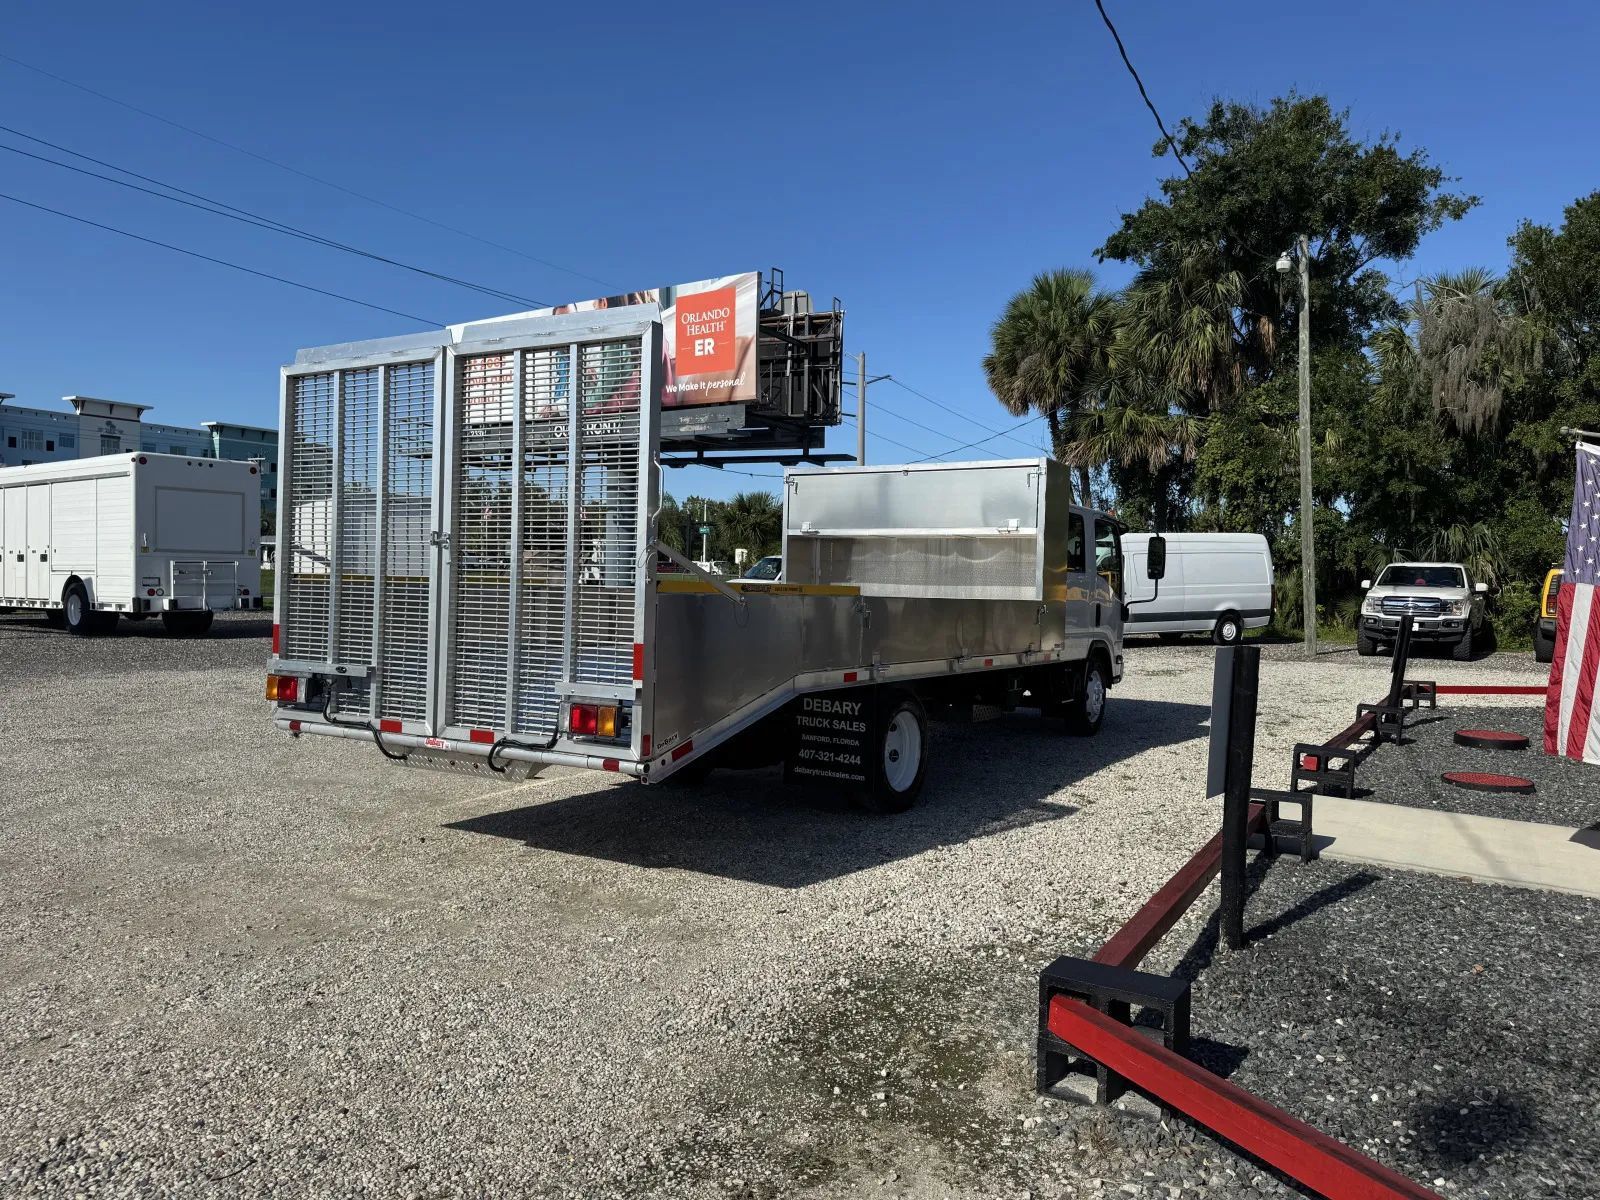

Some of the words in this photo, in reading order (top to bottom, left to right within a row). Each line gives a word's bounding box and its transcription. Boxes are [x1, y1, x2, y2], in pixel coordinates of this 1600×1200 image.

[681, 307, 730, 325] ORLANDO
[687, 321, 724, 336] HEALTH
[694, 337, 715, 357] ER
[665, 384, 677, 393] We
[678, 381, 699, 393] Make
[705, 371, 746, 397] personal
[803, 697, 862, 715] DEBARY
[796, 716, 830, 728] TRUCK
[832, 719, 866, 732] SALES
[833, 737, 860, 746] FLORIDA
[798, 748, 861, 766] 407-321-4244
[794, 766, 865, 781] debarytrucksales.com
